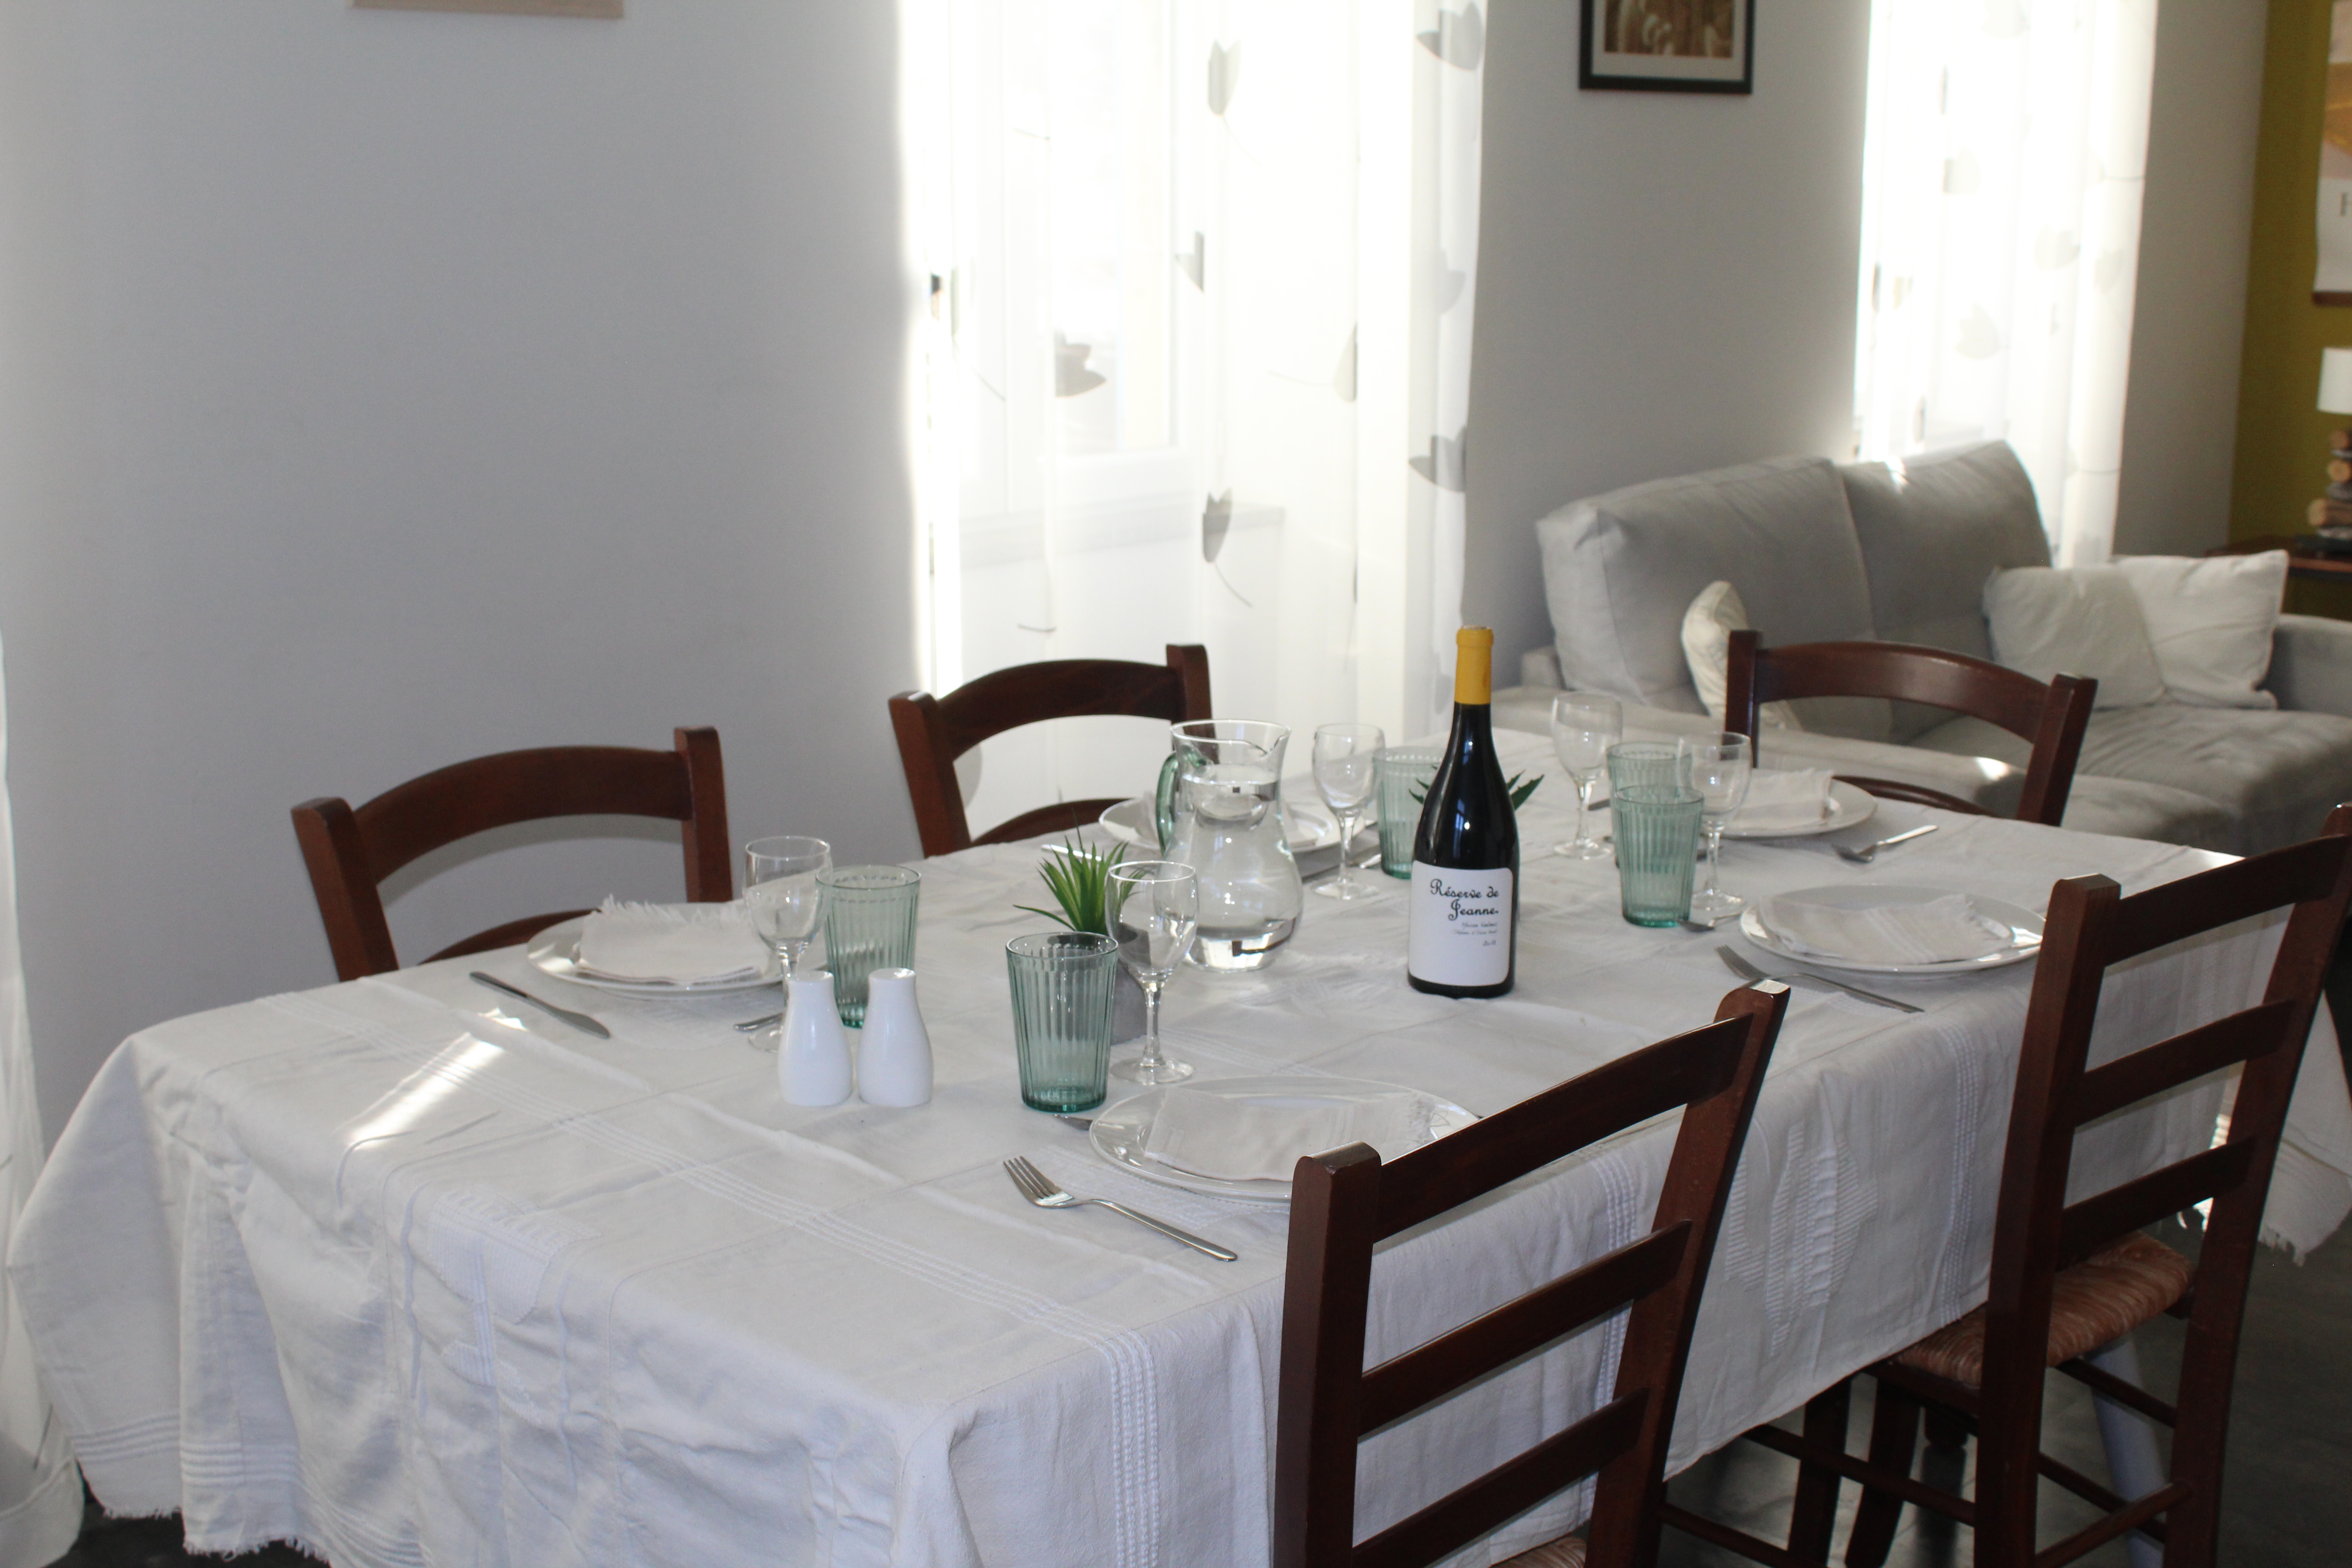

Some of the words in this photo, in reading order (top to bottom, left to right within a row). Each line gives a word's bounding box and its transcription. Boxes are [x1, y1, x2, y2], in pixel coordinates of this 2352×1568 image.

[1431, 879, 1482, 898] Réserve
[1487, 886, 1499, 897] de
[1448, 899, 1499, 921] Jeanne
